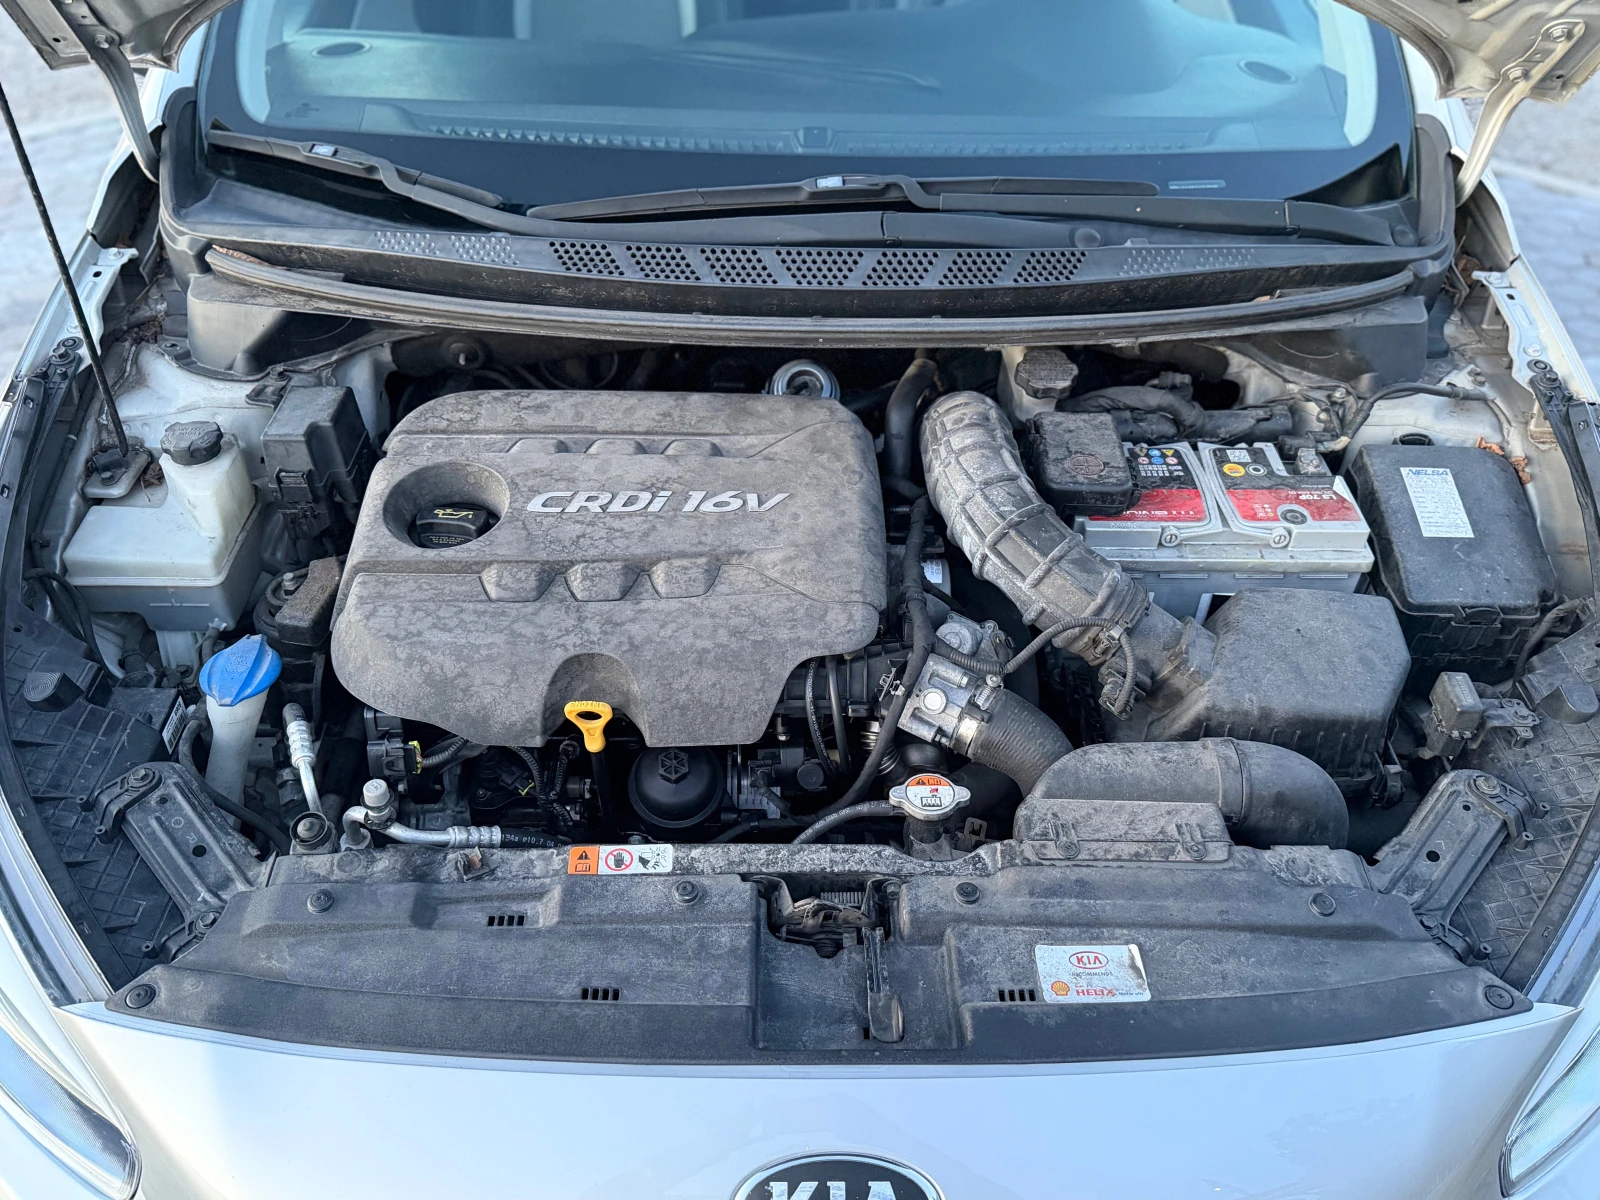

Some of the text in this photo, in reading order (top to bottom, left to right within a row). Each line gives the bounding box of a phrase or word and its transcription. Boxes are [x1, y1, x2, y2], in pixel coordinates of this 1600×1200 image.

[527, 490, 791, 513] CRDi 16V
[1075, 955, 1103, 966] KIA
[1075, 988, 1116, 998] HELIX
